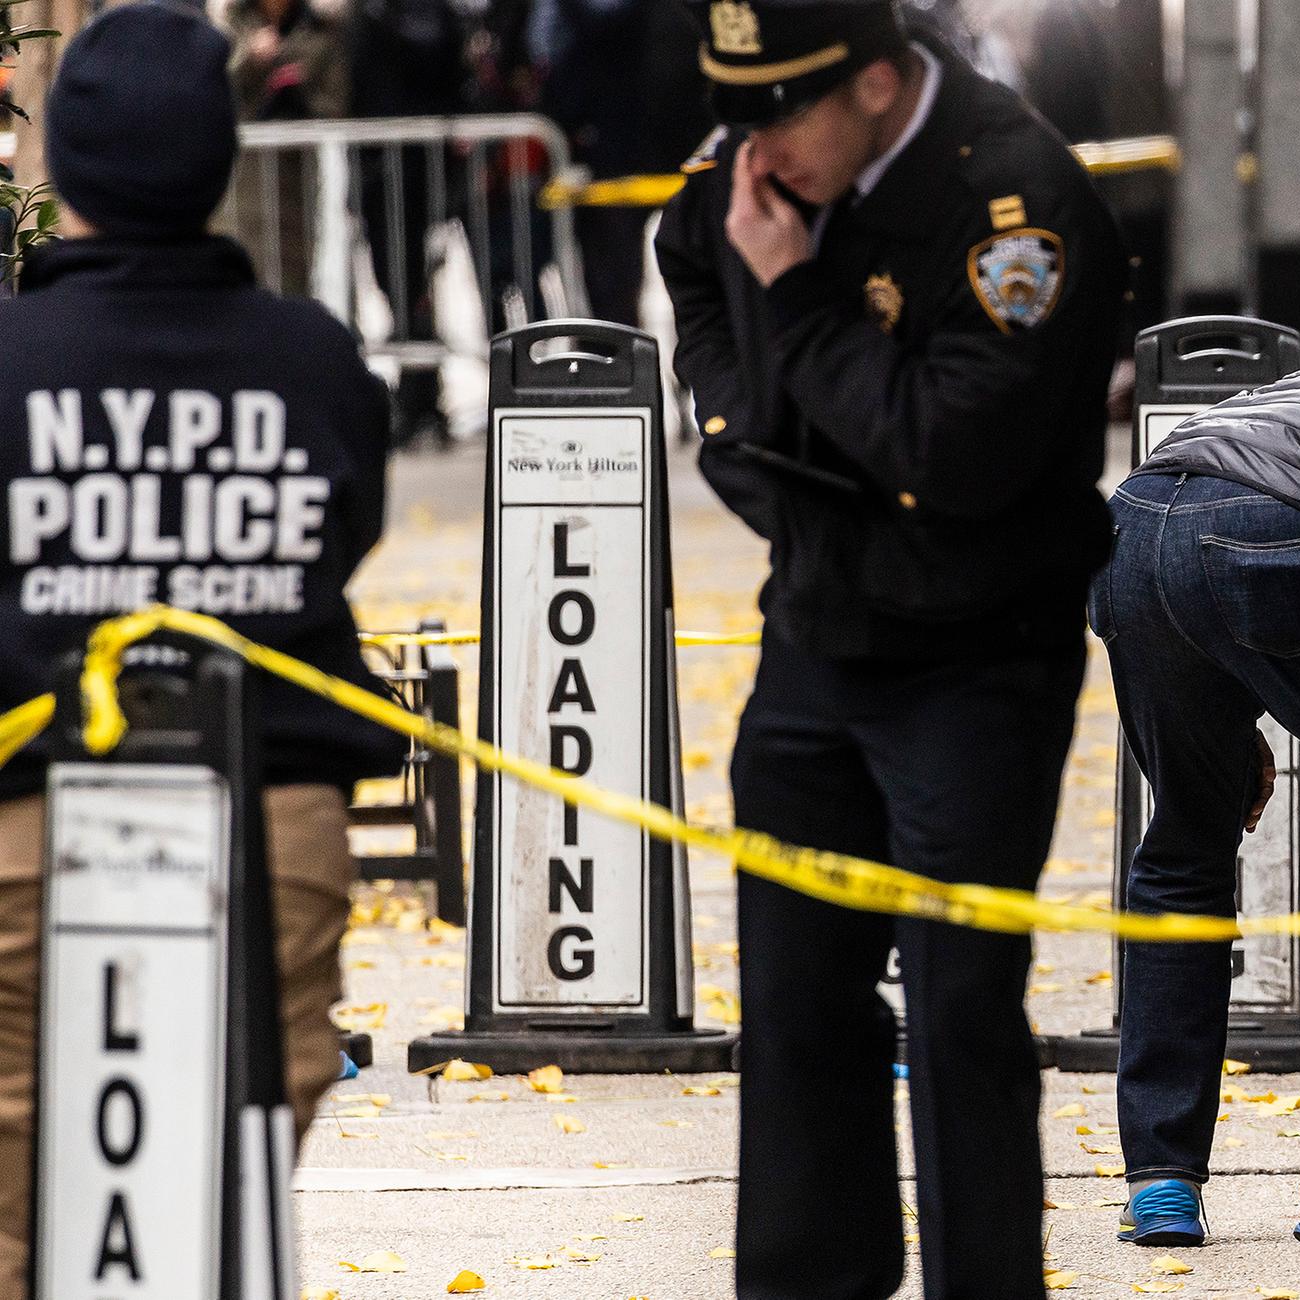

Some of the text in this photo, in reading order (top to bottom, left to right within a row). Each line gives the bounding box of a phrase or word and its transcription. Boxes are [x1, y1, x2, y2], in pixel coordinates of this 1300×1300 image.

[26, 387, 310, 474] N.Y.P.D.
[507, 457, 638, 473] New York Hilton
[8, 472, 331, 566] POLICE
[21, 565, 305, 616] CRIME SCENE
[546, 523, 597, 982] LOADING
[93, 958, 145, 1300] LOA
